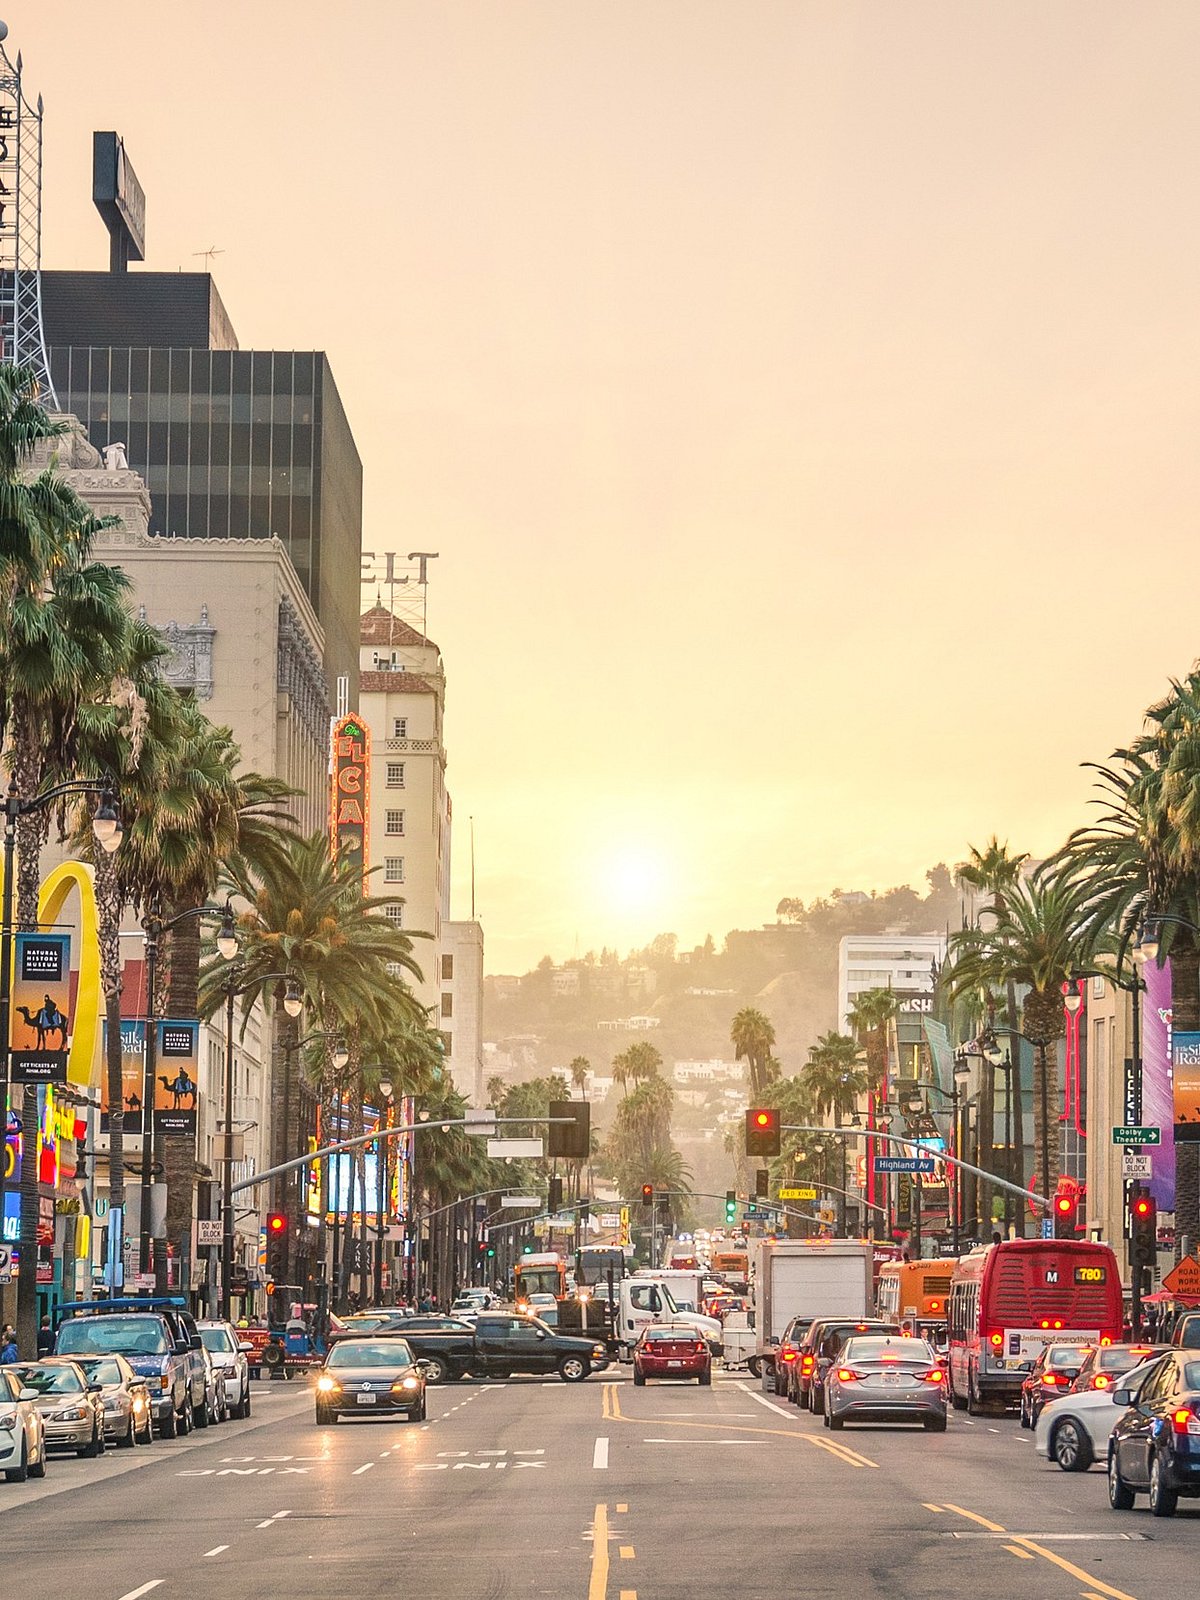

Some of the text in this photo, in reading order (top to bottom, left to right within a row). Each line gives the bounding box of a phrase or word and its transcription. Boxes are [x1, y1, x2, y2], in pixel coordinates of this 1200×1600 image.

[338, 736, 365, 762] EL
[121, 1039, 142, 1053] oad
[880, 1161, 929, 1170] Highland Av
[1046, 1271, 1058, 1282] M
[1079, 1268, 1101, 1281] 780
[1020, 1334, 1056, 1342] Unlimited
[175, 1467, 314, 1475] XING
[414, 1462, 546, 1470] XING
